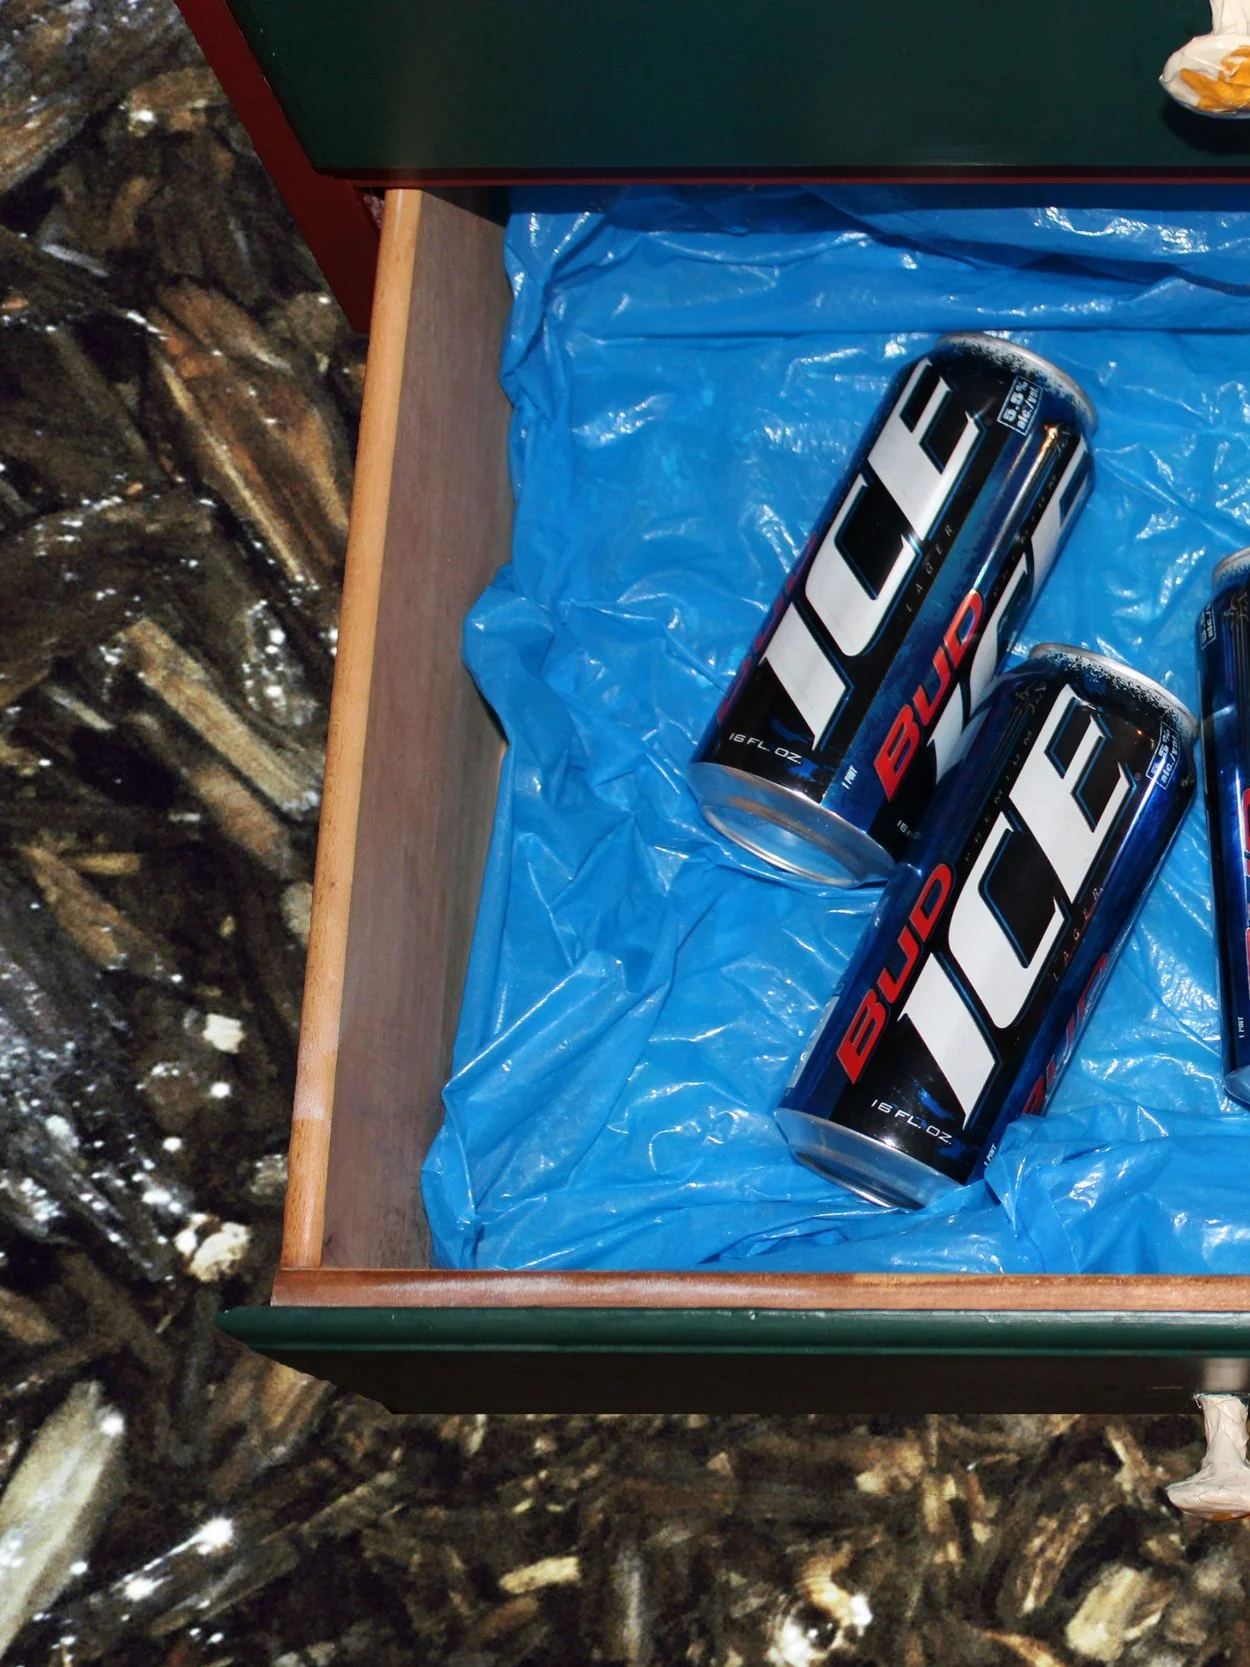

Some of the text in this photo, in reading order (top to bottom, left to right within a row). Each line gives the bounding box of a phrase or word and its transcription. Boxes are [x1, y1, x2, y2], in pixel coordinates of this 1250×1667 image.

[758, 358, 980, 751] ICE
[906, 524, 952, 612] LAGER
[874, 589, 983, 801] BUD
[729, 733, 802, 764] 16 FL. OZ.
[847, 765, 859, 785] PINT
[898, 684, 1131, 1131] ICE
[1053, 887, 1104, 981] LAGER
[837, 864, 953, 1085] BUD
[871, 1099, 952, 1145] 16 FL. OZ.
[986, 1143, 997, 1162] PINT
